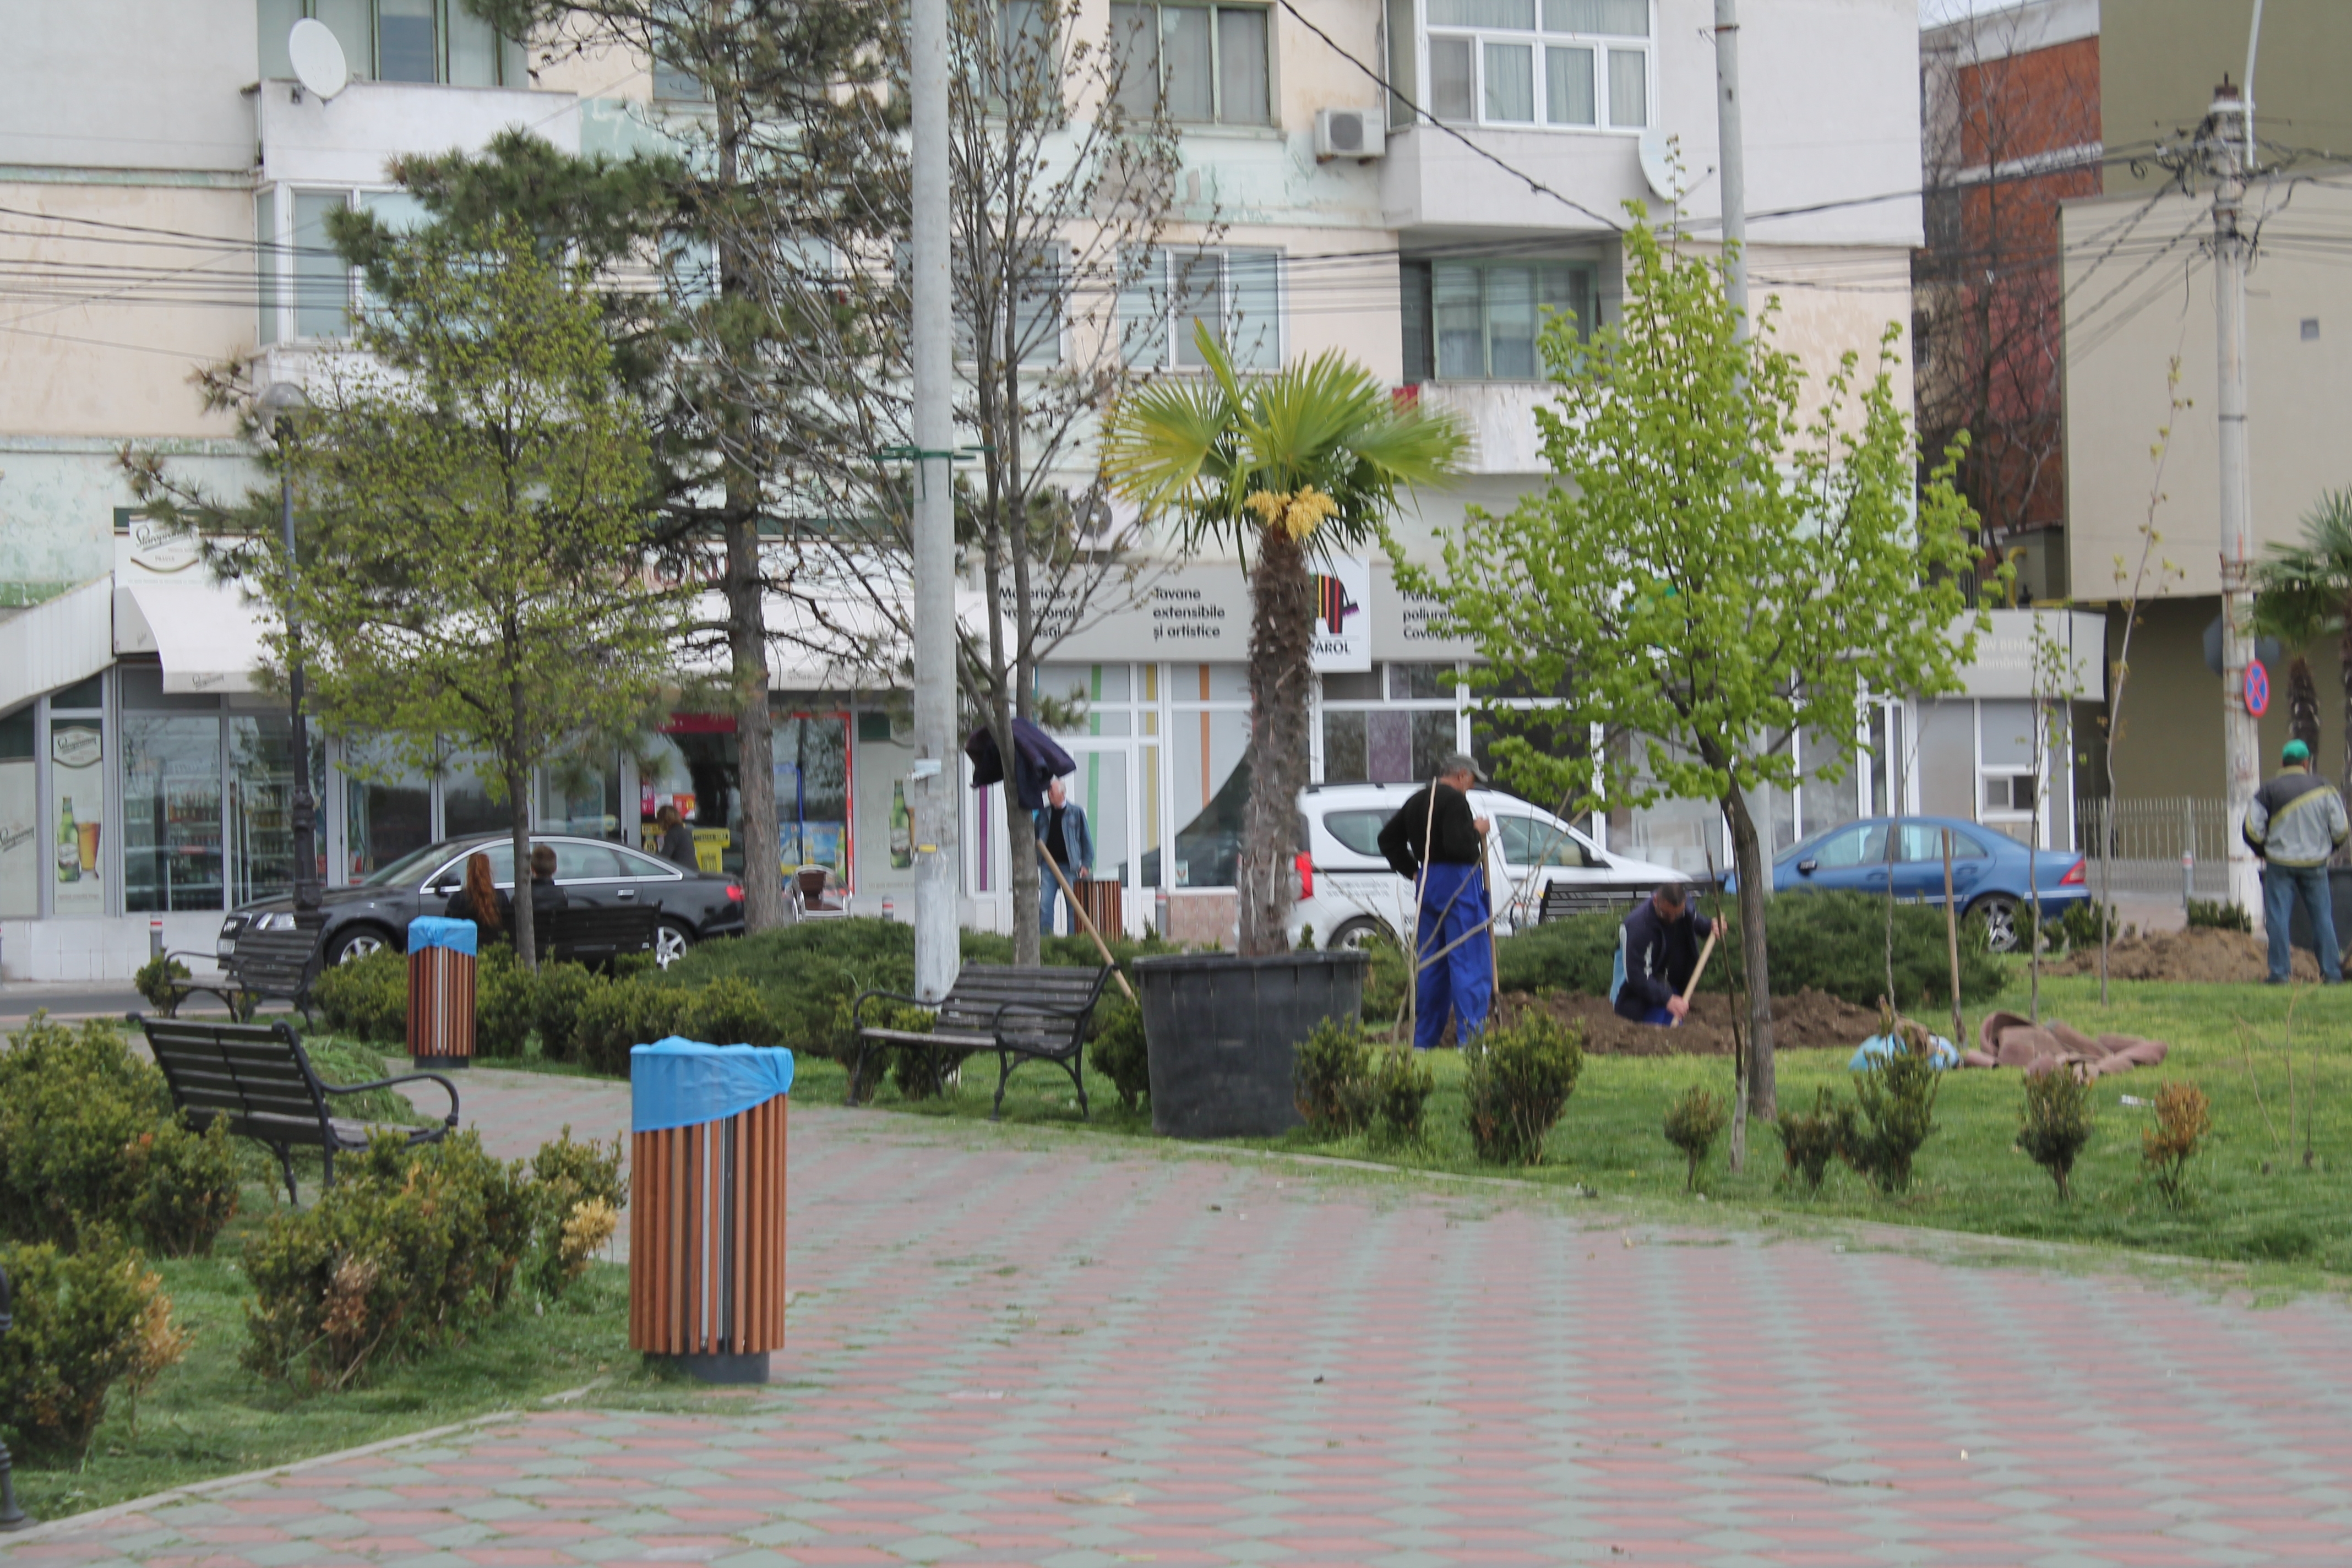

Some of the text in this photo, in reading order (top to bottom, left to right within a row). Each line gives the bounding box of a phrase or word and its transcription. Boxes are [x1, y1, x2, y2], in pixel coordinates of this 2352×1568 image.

[1154, 586, 1201, 600] Tavane
[1153, 604, 1225, 619] extensibile
[1167, 623, 1220, 638] artistice
